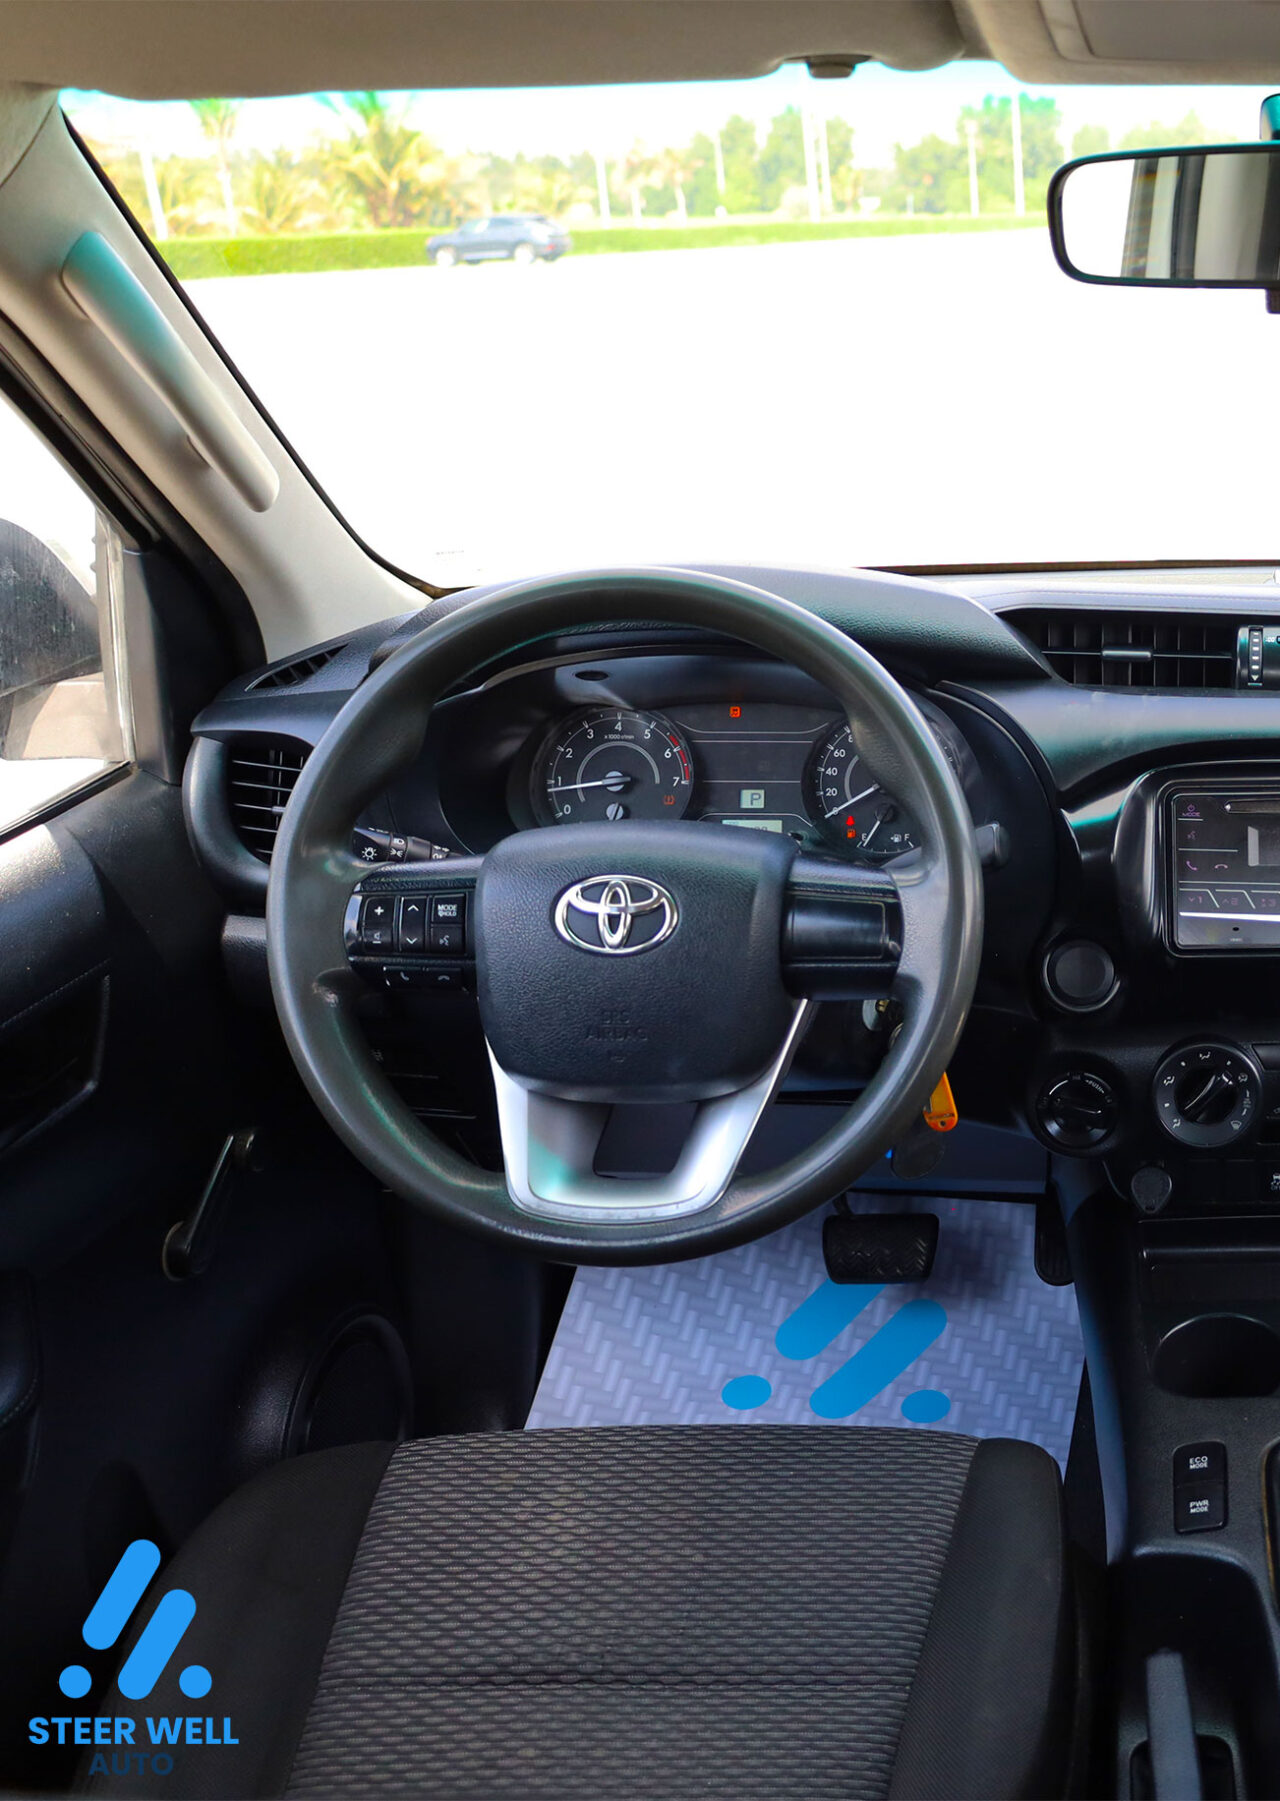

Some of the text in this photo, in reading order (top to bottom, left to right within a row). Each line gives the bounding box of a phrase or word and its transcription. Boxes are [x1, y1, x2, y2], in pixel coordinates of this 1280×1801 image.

[614, 721, 622, 731] 4
[586, 729, 594, 739] 3
[643, 729, 651, 739] 5
[565, 748, 573, 758] 2
[664, 748, 672, 758] 6
[833, 749, 846, 758] 60
[825, 767, 838, 776] 40
[557, 776, 562, 786] 1
[672, 776, 680, 787] 7
[825, 788, 838, 796] 20
[750, 792, 762, 806] P
[563, 804, 571, 814] 0
[861, 833, 867, 841] E
[904, 833, 910, 841] F
[437, 903, 458, 911] MODE
[1189, 1456, 1208, 1464] ECO
[1190, 1500, 1209, 1508] PWR
